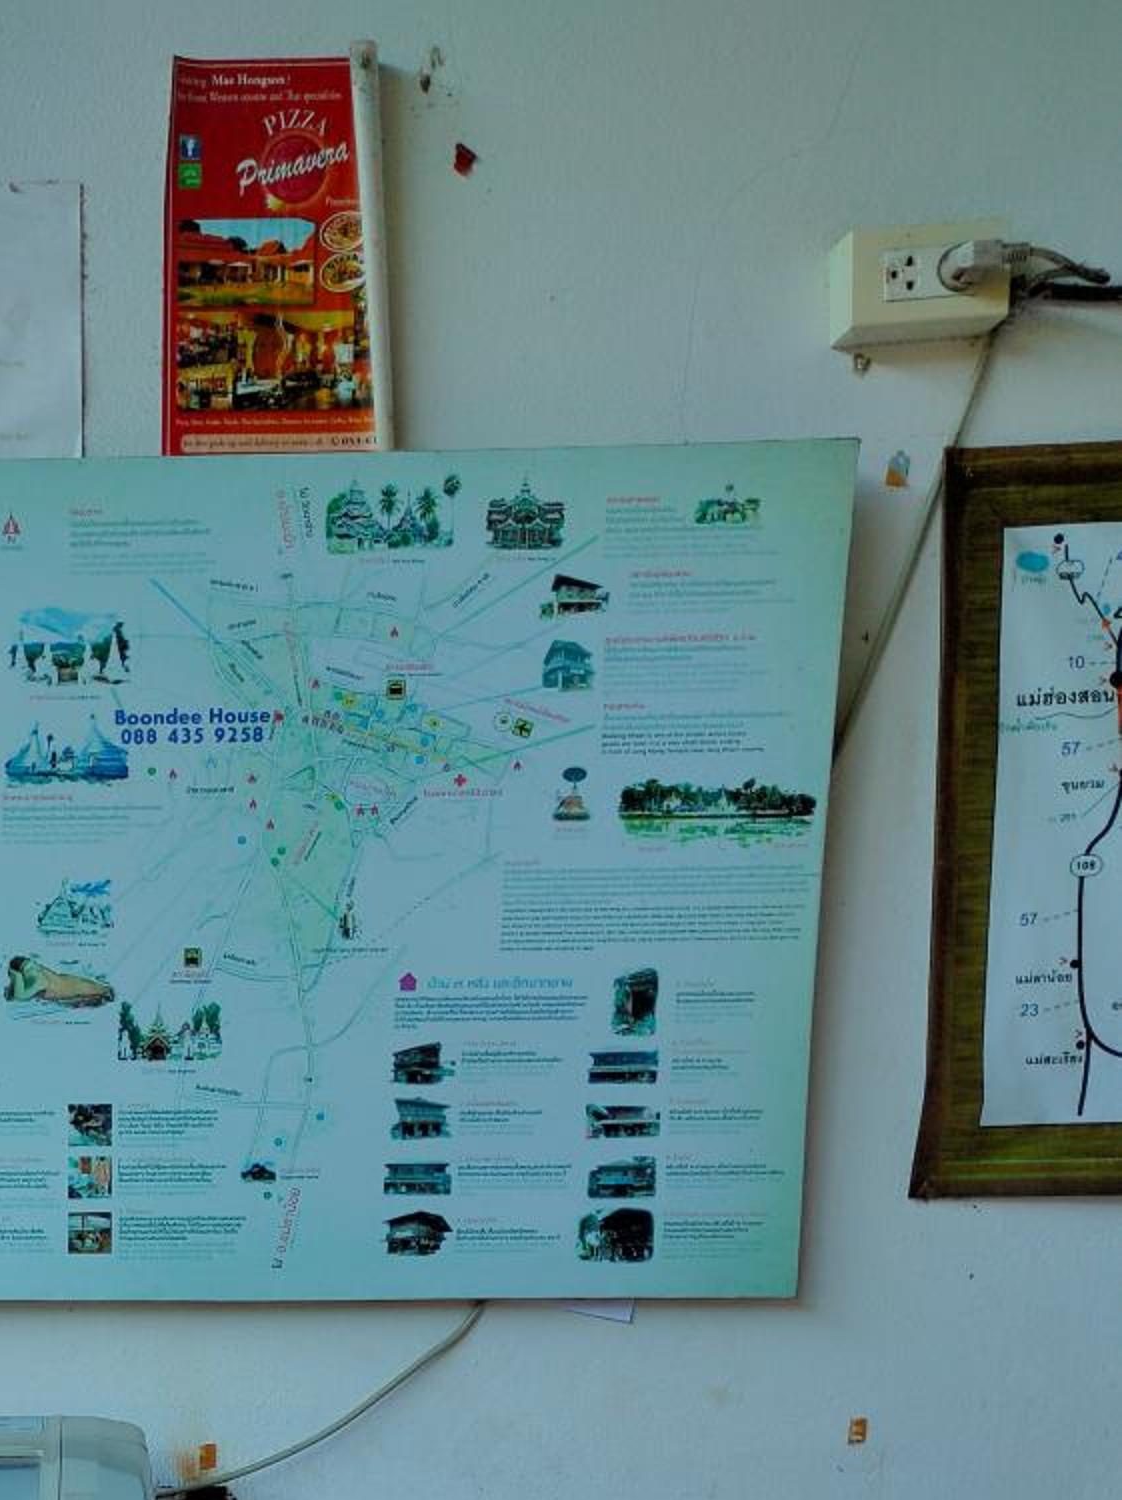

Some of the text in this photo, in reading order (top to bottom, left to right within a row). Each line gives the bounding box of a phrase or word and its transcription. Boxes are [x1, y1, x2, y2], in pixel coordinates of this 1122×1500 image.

[263, 108, 328, 136] PIZZA
[236, 141, 351, 197] Primavera
[1016, 687, 1114, 707] แม่ฮ่องสอน
[115, 708, 271, 725] Boondee House
[121, 727, 264, 744] 088 435 9258
[1061, 741, 1081, 756] 57
[1020, 912, 1039, 927] 57
[1020, 1003, 1039, 1017] 23
